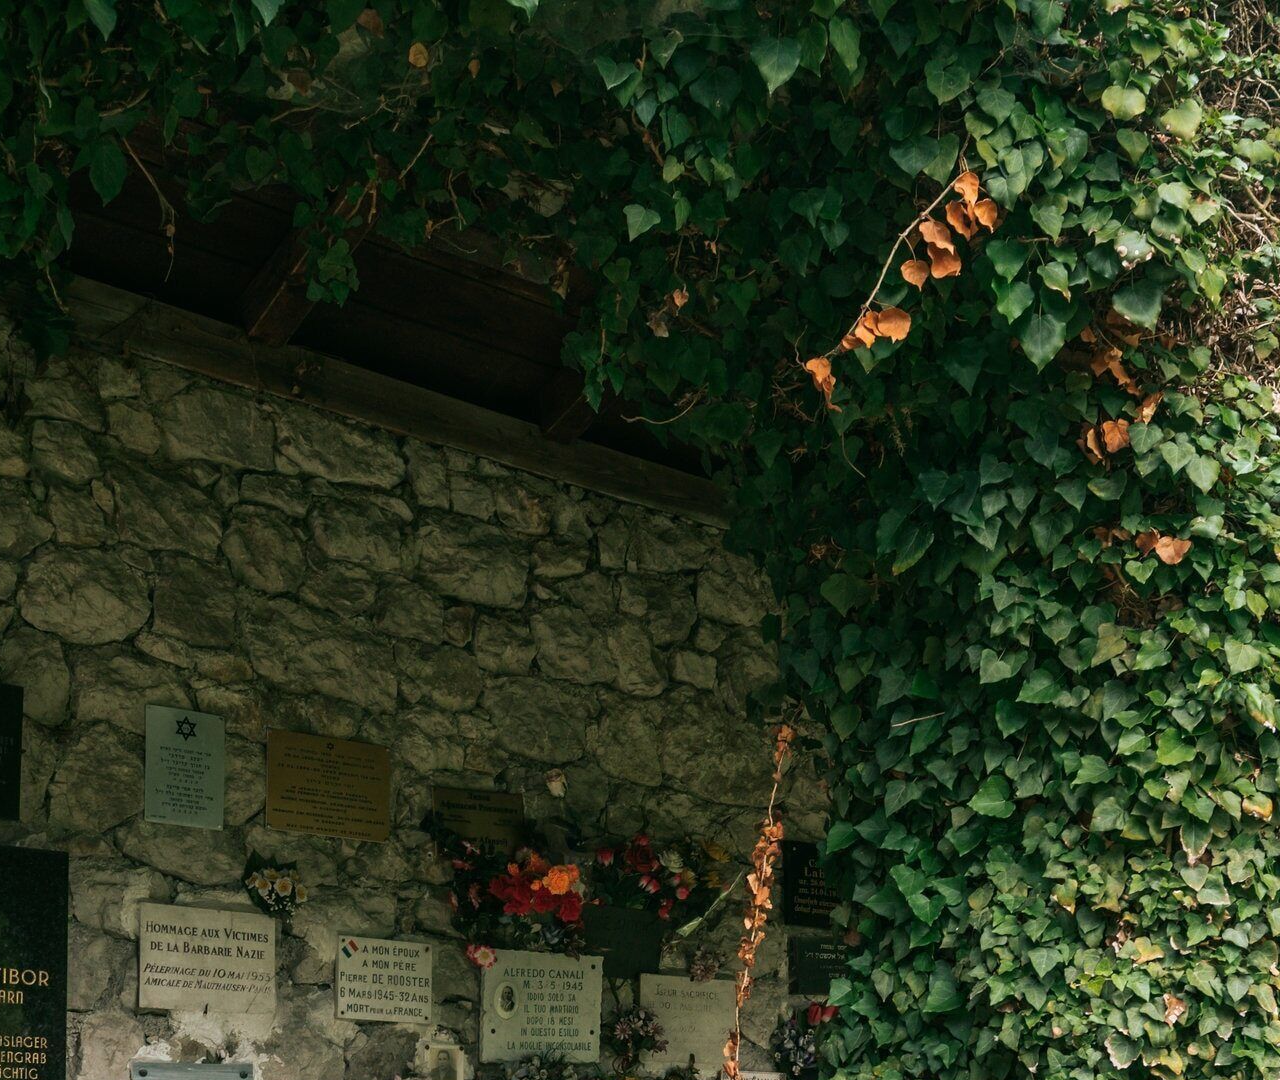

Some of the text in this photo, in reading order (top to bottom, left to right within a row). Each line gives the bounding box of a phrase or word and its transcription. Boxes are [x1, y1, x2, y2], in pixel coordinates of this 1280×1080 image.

[201, 928, 220, 938] AUX
[151, 941, 163, 951] DE
[167, 943, 179, 952] LA
[372, 946, 419, 958] MON ÉPOUX
[372, 960, 389, 969] MON
[504, 968, 584, 979] ALFREDO CANALI
[372, 974, 383, 984] DE
[388, 975, 430, 987] ROOSTER
[347, 1004, 369, 1012] MORT
[547, 1017, 554, 1025] 18
[521, 1028, 527, 1036] IN
[531, 1028, 555, 1036] QUESTO
